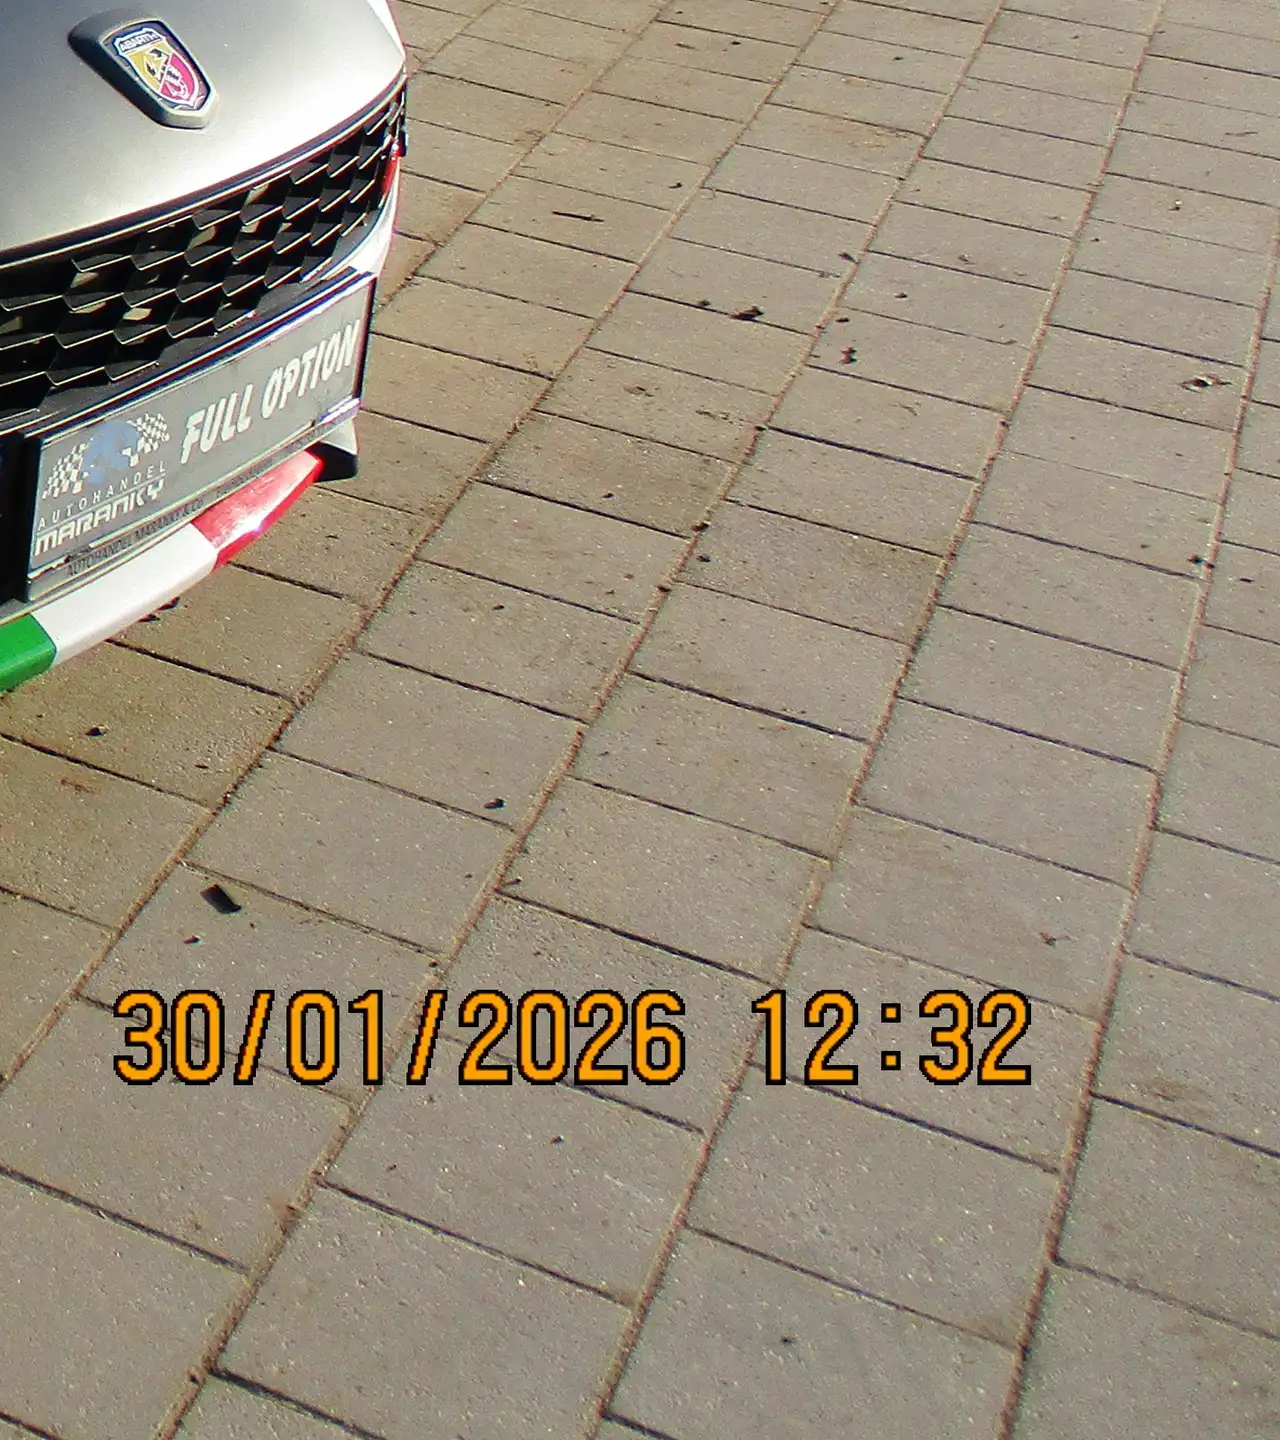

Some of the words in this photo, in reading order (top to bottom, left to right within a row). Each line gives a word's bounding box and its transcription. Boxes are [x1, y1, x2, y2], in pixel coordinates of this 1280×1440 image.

[119, 32, 159, 52] ABARTH
[180, 383, 254, 464] FULL
[261, 319, 360, 419] OPTION
[38, 460, 166, 531] AUTOHANDEL
